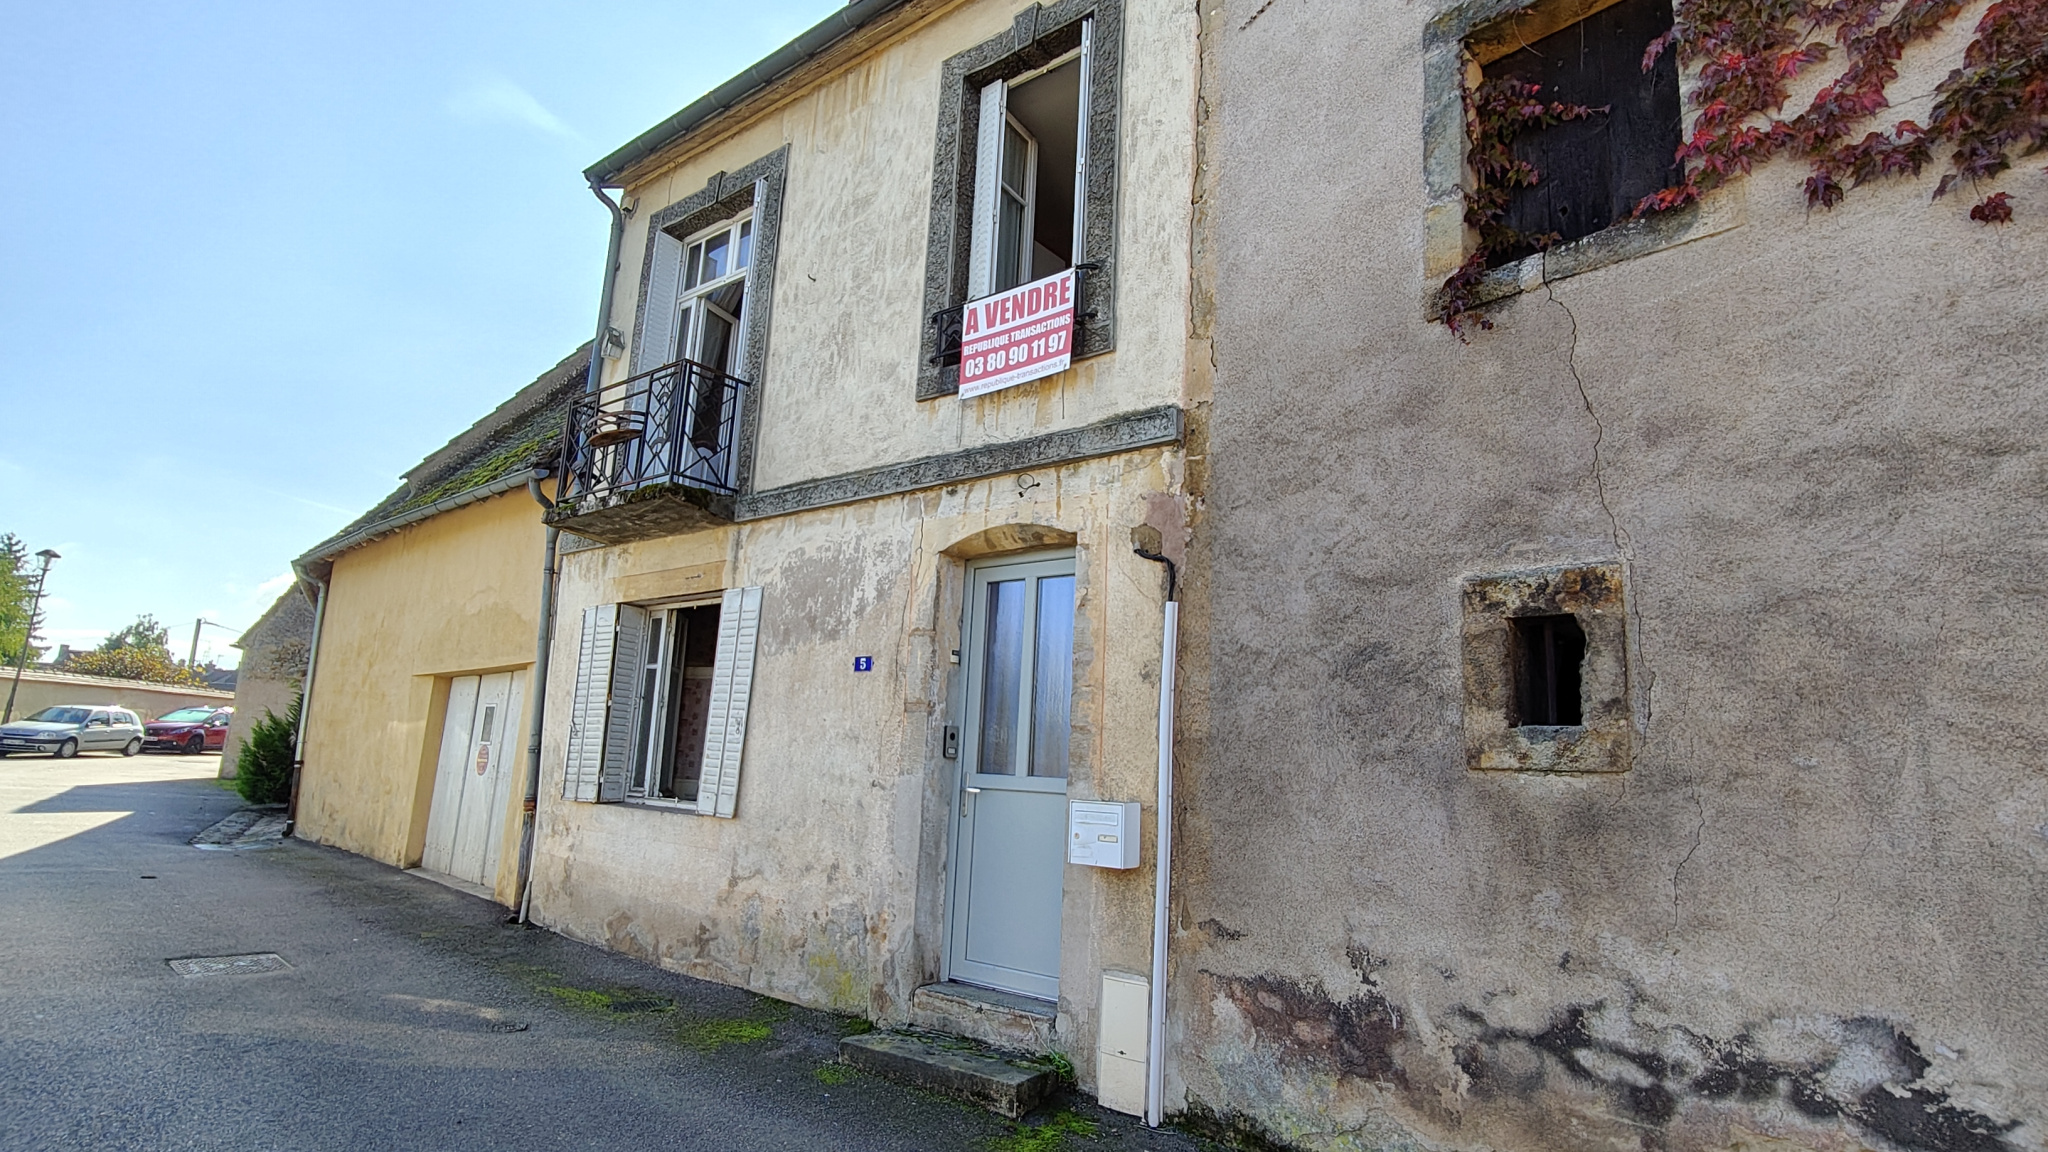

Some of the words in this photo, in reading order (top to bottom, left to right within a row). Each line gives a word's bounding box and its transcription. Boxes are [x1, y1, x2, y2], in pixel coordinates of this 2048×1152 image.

[965, 307, 979, 336] A
[985, 276, 1071, 329] VENDRE
[963, 333, 1009, 356] REPUBLIQUE
[1010, 313, 1071, 343] TRANSACTIONS
[965, 356, 984, 378] 03
[986, 350, 1006, 372] 80
[1008, 343, 1028, 365] 90
[1031, 337, 1046, 359] 11
[1048, 330, 1067, 353] 97
[963, 358, 1065, 394] www.republique-transactions.fr
[859, 657, 867, 670] 5
